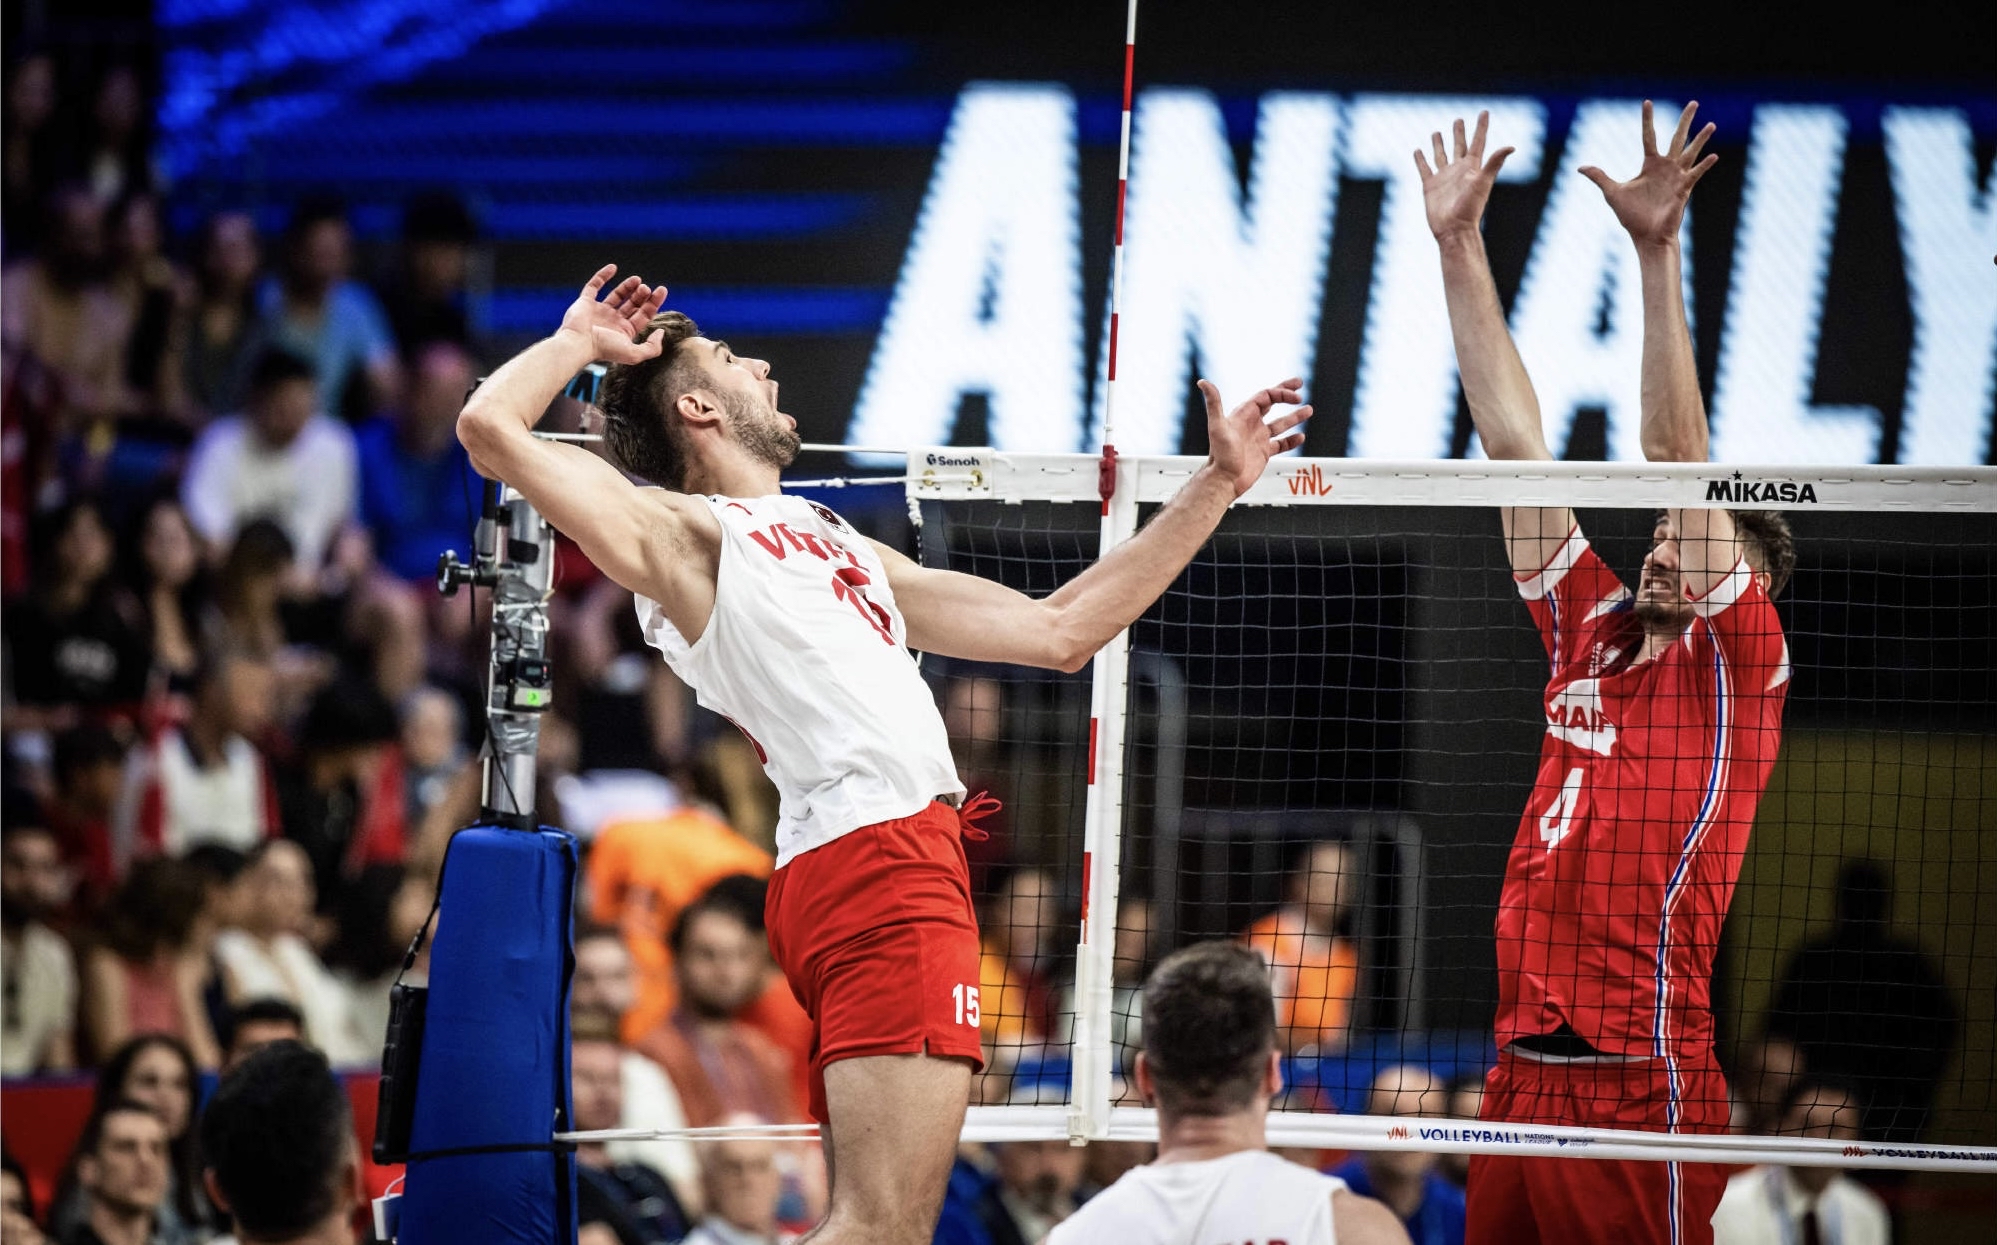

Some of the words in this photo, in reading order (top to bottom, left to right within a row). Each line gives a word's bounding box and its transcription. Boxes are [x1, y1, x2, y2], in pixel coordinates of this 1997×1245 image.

[845, 80, 1997, 466] ANTALY
[937, 456, 980, 466] Senoh
[1705, 480, 1818, 504] MIKASA
[1540, 767, 1584, 855] 4
[952, 982, 980, 1028] 15
[1419, 1127, 1521, 1144] VOLLEYBALL
[1524, 1133, 1554, 1141] NATIONS
